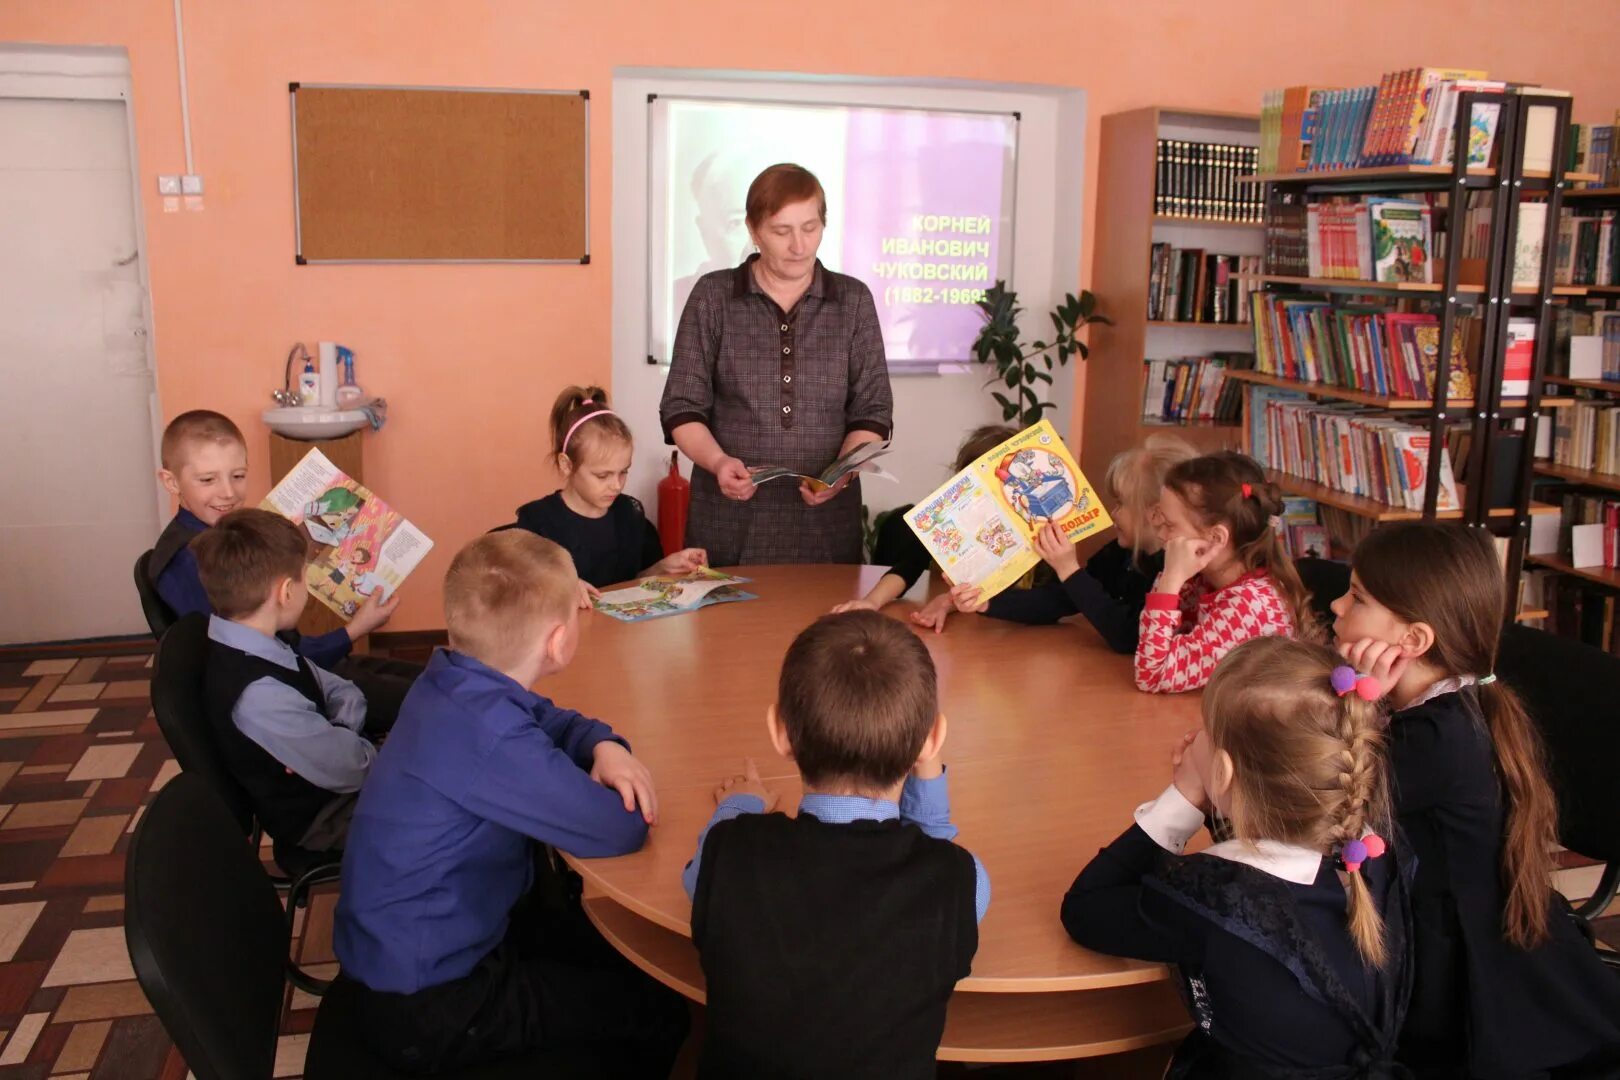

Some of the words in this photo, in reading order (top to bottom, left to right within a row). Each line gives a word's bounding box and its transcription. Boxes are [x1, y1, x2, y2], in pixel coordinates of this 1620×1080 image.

[912, 215, 991, 234] КОРНЕЙ
[882, 238, 990, 258] ИВАНОВИЧ
[872, 262, 988, 281] ЧУКОВСКИЙ
